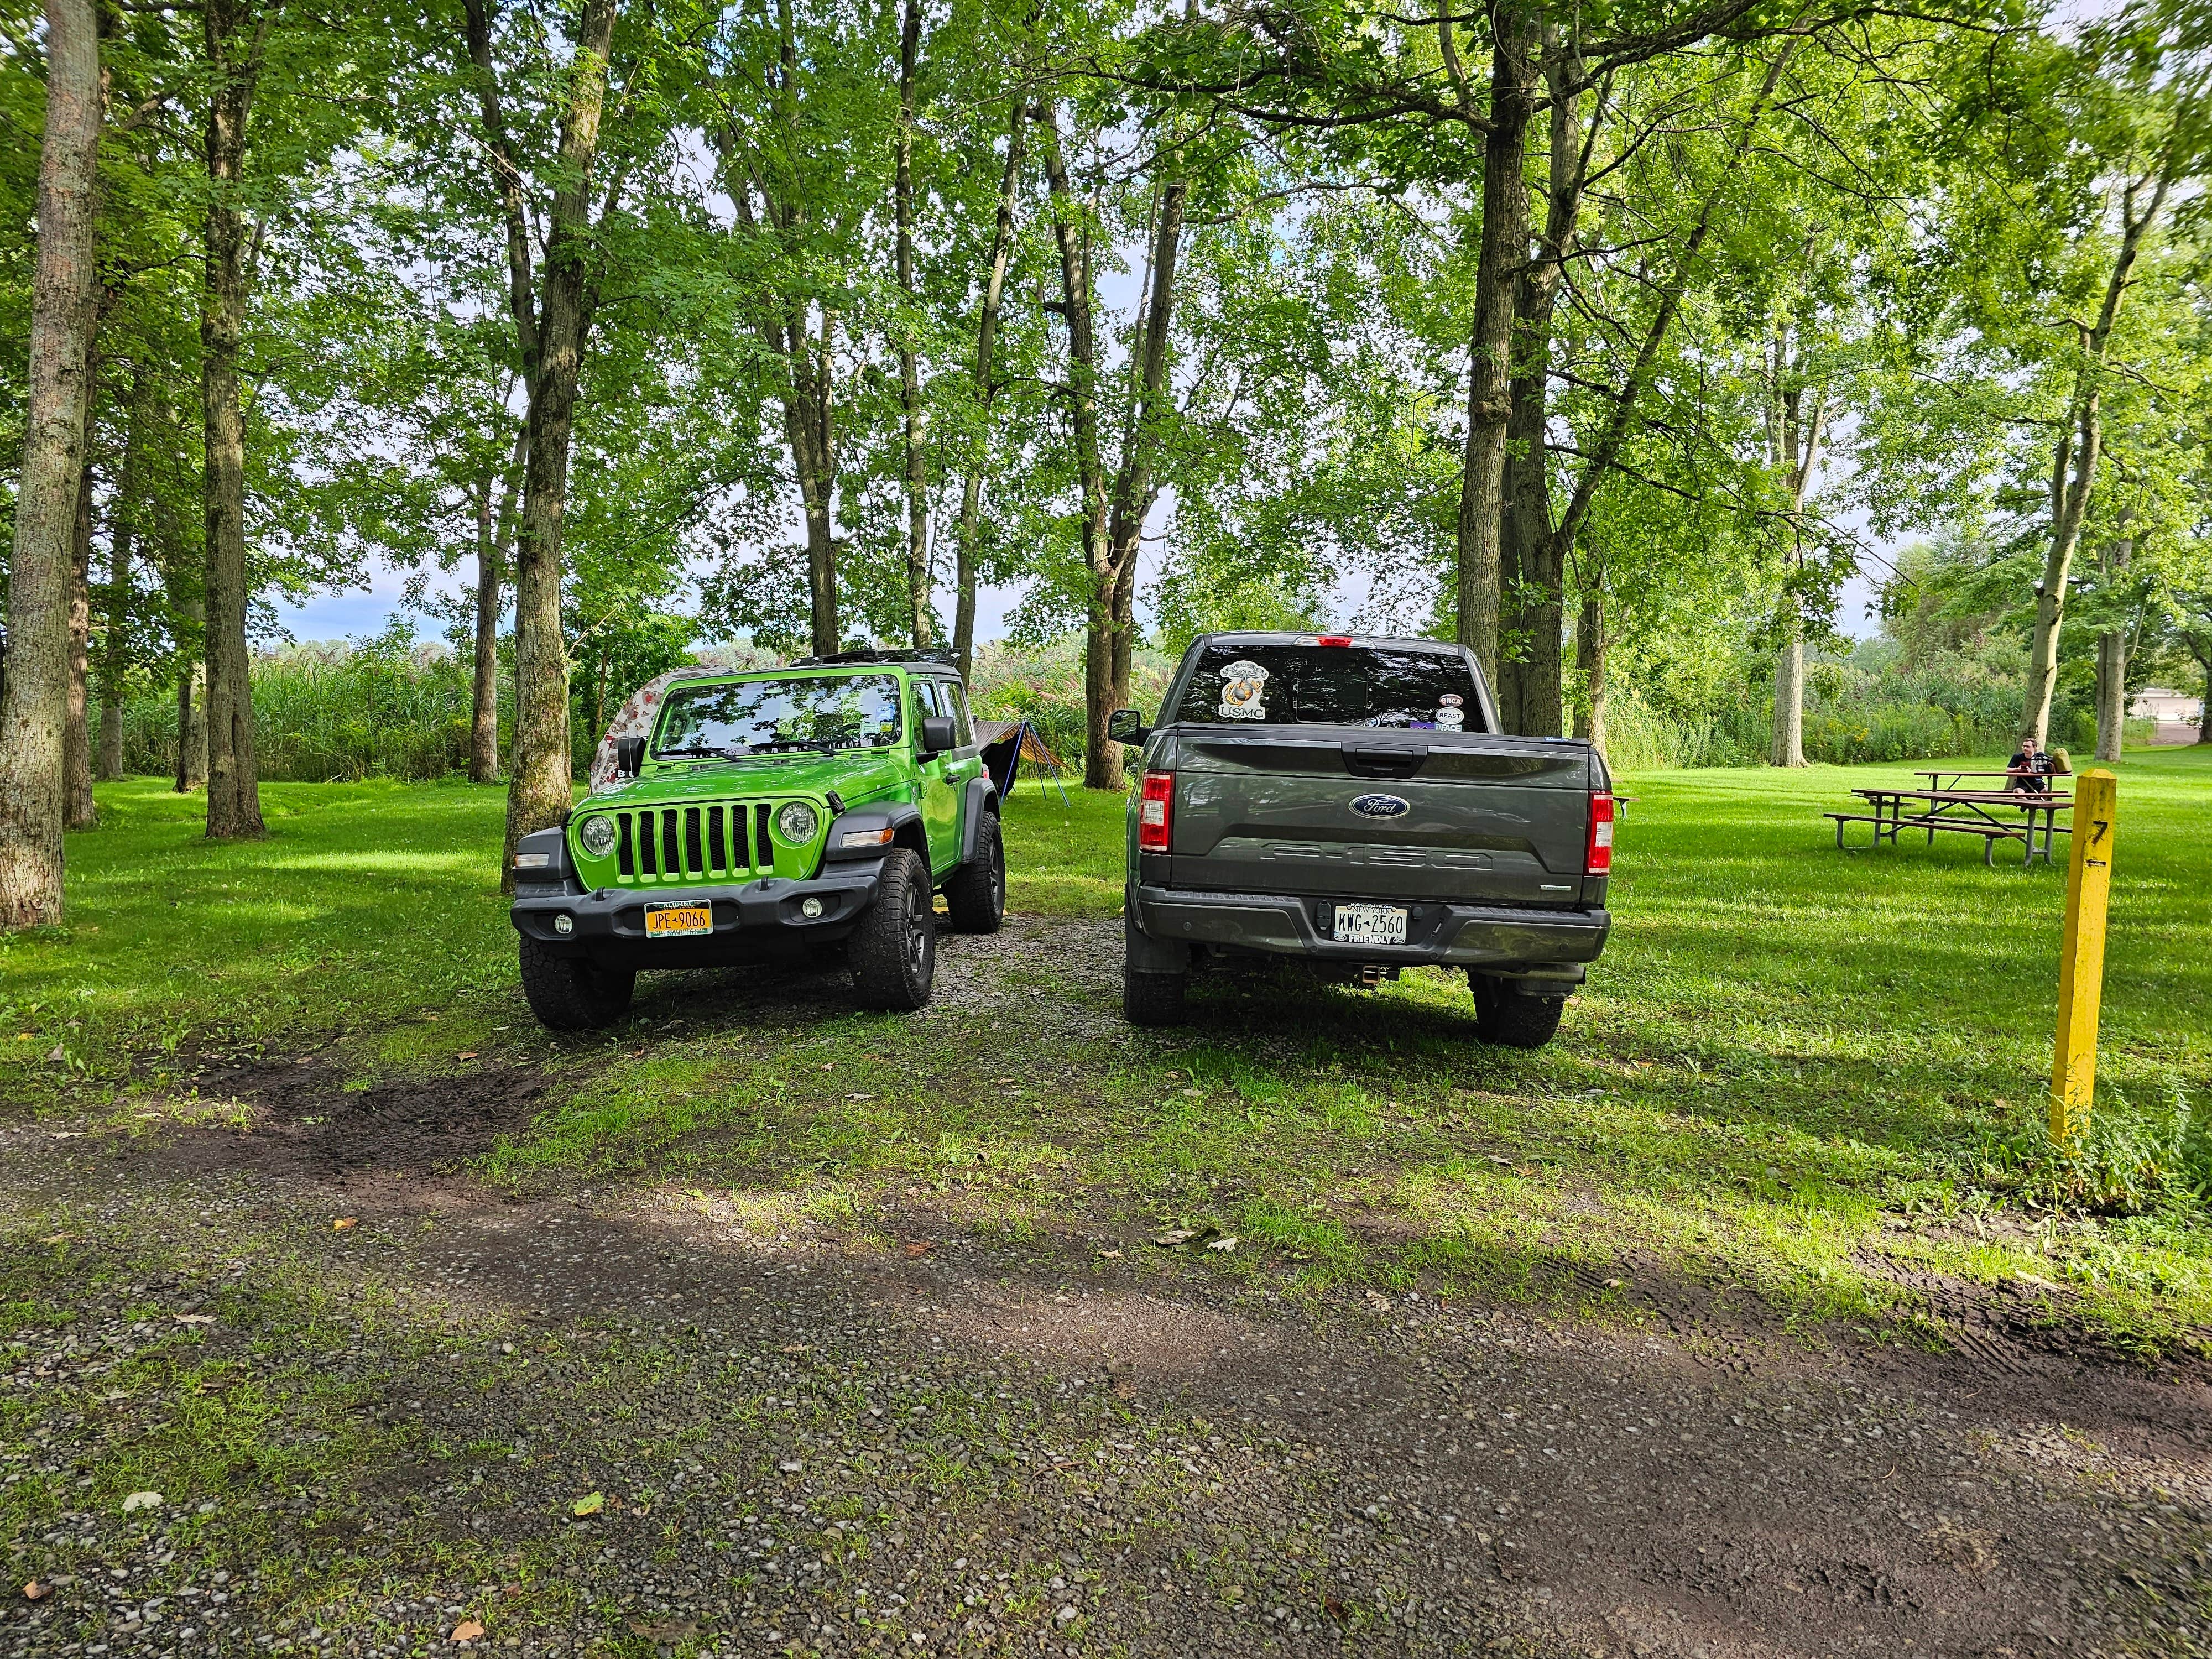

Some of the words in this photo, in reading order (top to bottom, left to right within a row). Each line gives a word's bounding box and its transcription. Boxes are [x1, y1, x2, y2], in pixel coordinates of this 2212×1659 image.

[1220, 706, 1264, 718] USMC
[1364, 799, 1397, 813] Ford
[2091, 820, 2108, 846] 7
[1259, 842, 1493, 871] F-150
[653, 912, 671, 929] JPE
[679, 911, 705, 927] 9066
[1339, 913, 1361, 932] KWG
[1371, 915, 1403, 933] 2560
[1349, 934, 1392, 945] FRIENDLY
